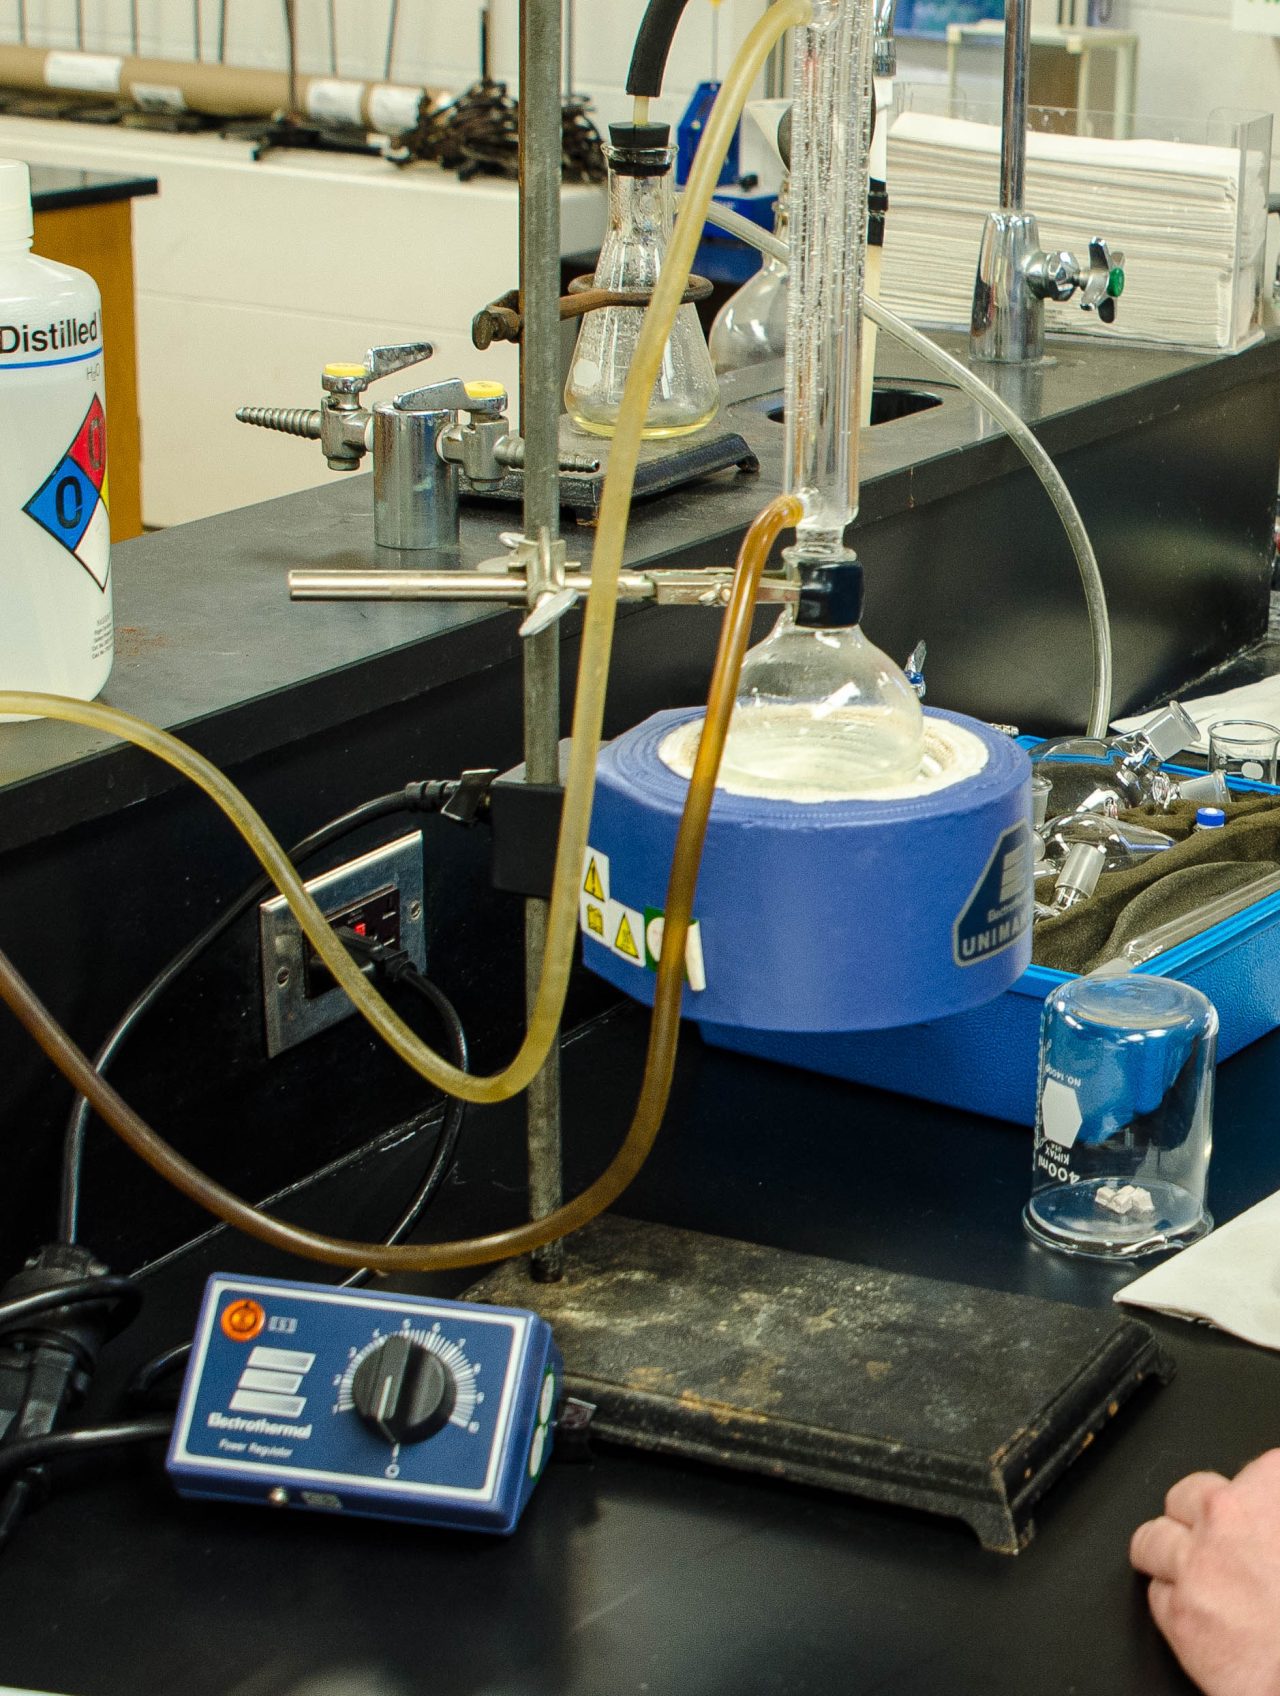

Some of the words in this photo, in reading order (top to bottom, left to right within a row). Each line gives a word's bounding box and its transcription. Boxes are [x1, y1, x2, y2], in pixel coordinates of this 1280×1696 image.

[0, 309, 97, 354] Distilled
[55, 475, 83, 529] 0
[1037, 1154, 1081, 1185] 400ml
[1044, 1143, 1070, 1166] KIMAX
